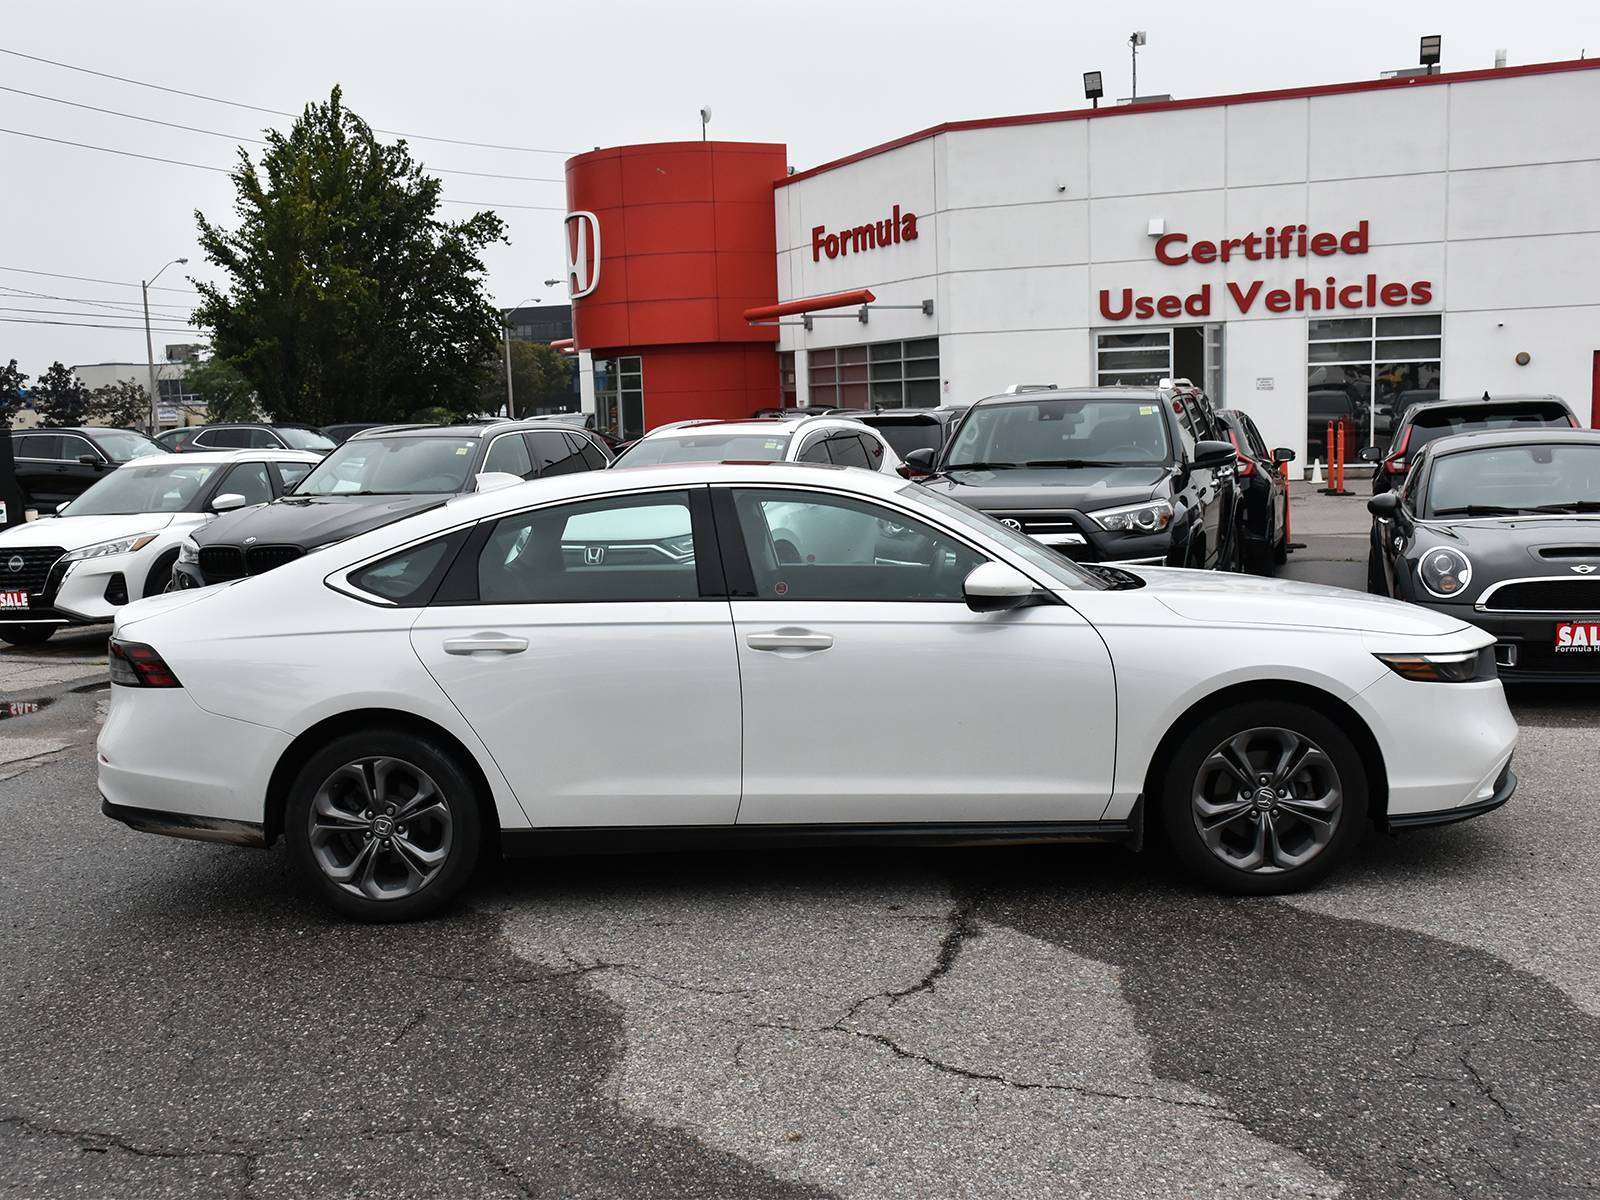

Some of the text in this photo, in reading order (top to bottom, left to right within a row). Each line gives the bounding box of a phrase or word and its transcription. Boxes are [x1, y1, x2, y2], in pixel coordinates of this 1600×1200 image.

[812, 204, 918, 262] Formula
[1154, 220, 1369, 266] Certified
[1099, 274, 1433, 321] Used Vehicles
[0, 592, 28, 606] SALE
